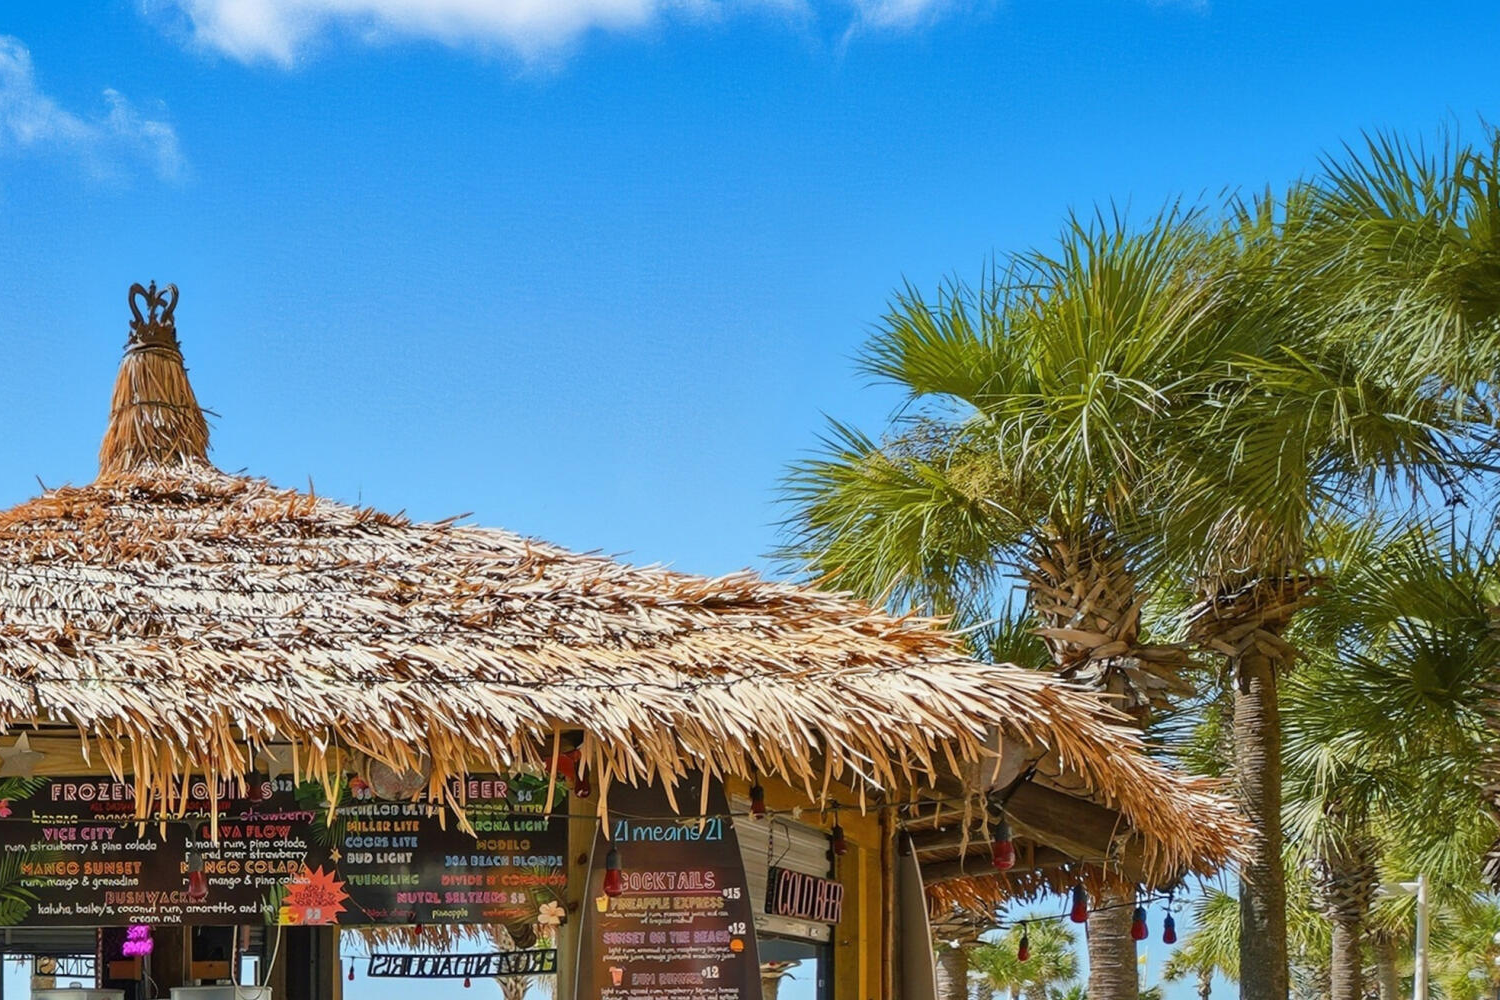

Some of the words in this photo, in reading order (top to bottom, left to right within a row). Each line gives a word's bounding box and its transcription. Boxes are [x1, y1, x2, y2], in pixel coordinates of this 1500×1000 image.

[51, 783, 137, 801] FROZEN
[452, 780, 509, 799] BEER
[31, 810, 79, 824] banana
[239, 807, 316, 824] strawberry
[336, 805, 400, 816] MICHELOB
[246, 825, 292, 839] FLOW
[346, 821, 391, 832] MILLER
[393, 821, 420, 832] LITE
[513, 820, 549, 832] LIGHT
[614, 819, 629, 842] 21
[633, 825, 701, 841] means
[705, 817, 723, 840] 21
[42, 827, 77, 841] VICE
[80, 827, 117, 841] CITY
[30, 841, 89, 854] strawberry
[90, 841, 99, 851] &
[124, 840, 158, 851] colada
[345, 836, 389, 848] COORS
[391, 836, 419, 848] LITE
[475, 839, 531, 851] MODELO
[223, 851, 247, 860] over
[249, 850, 309, 862] strawberry
[346, 852, 374, 864] BUD
[376, 852, 413, 863] LIGHT
[470, 855, 510, 867] BEACH
[512, 855, 564, 867] BLONDE
[20, 861, 80, 876] MANGO
[83, 861, 143, 876] SUNSET
[243, 860, 308, 874] COLADA
[46, 880, 80, 891] mango
[81, 877, 90, 887] &
[91, 875, 140, 891] grenadine
[208, 877, 242, 890] mango
[243, 876, 252, 886] &
[346, 873, 421, 885] YUENGLING
[620, 870, 716, 891] COCKTAILS
[444, 892, 509, 904] SELTZERS
[722, 887, 741, 899] $15
[778, 869, 814, 918] COLD
[814, 879, 845, 922] BEER
[117, 904, 157, 914] coconut
[239, 901, 257, 913] and
[610, 897, 670, 910] PINEAPPLE
[673, 896, 726, 909] EXPRESS
[129, 914, 161, 924] cream
[163, 914, 182, 923] mix
[431, 907, 469, 920] pineapple
[728, 922, 747, 935] $12
[603, 931, 646, 945] SUNSET
[649, 931, 667, 944] ON
[669, 931, 691, 944] THE
[693, 930, 731, 944] BEACH
[701, 965, 720, 979] $12
